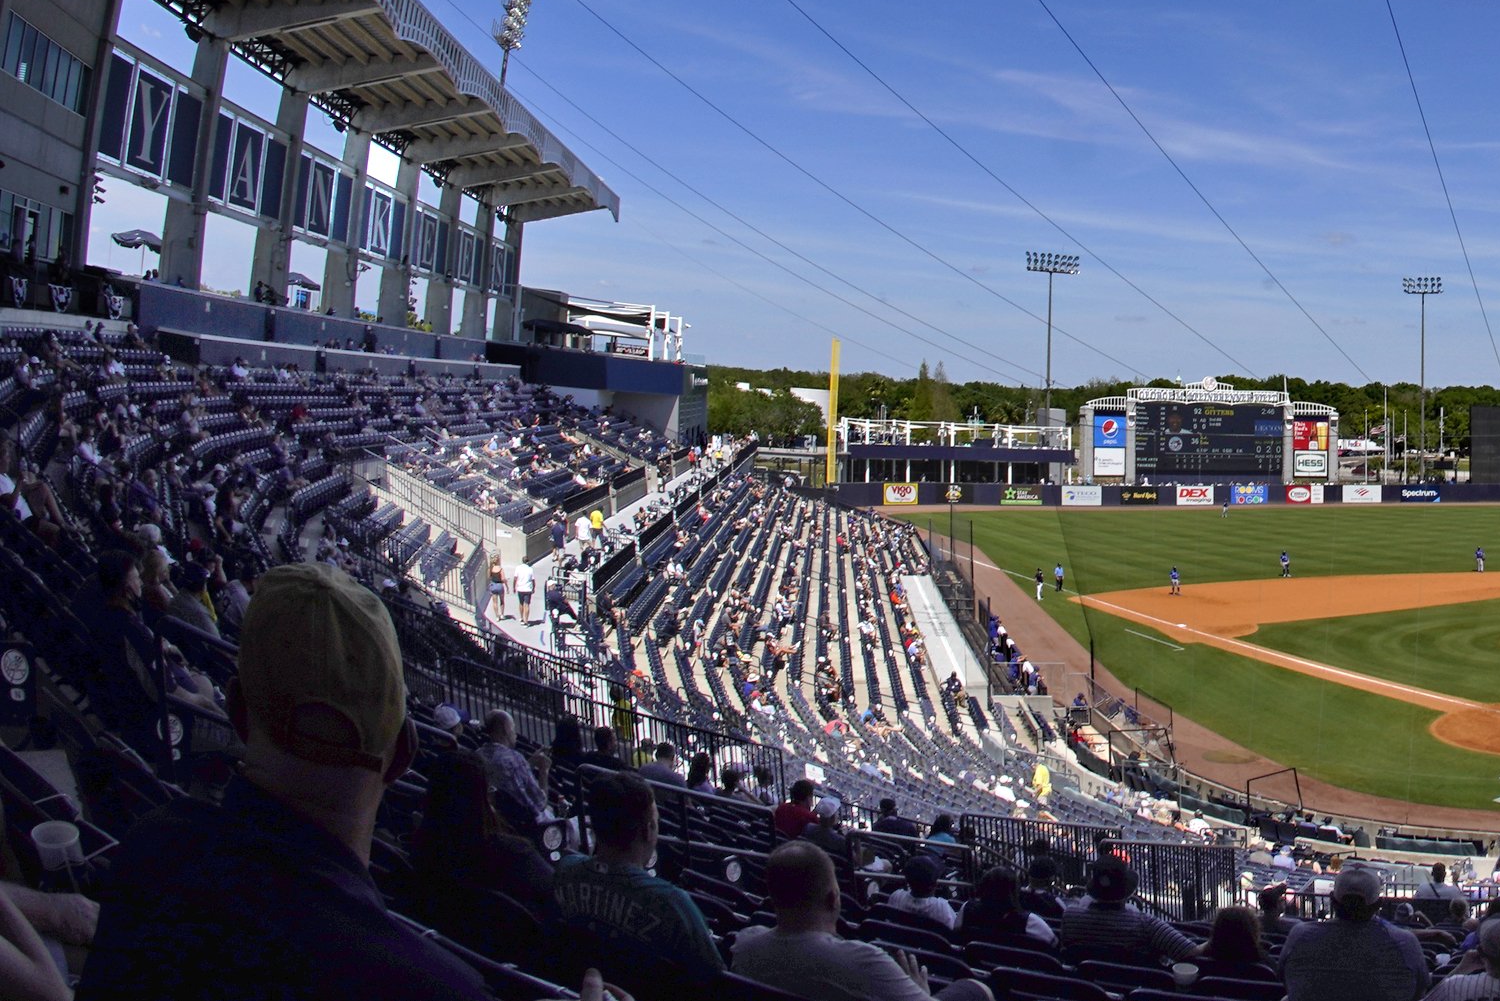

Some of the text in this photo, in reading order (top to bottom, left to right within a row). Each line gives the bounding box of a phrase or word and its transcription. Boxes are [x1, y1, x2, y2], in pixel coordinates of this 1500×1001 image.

[1298, 459, 1323, 467] HESS
[1179, 488, 1208, 498] DEX
[1234, 486, 1264, 494] ROOMS
[1402, 489, 1434, 498] Spectrum
[554, 881, 662, 943] MARTINEZ
